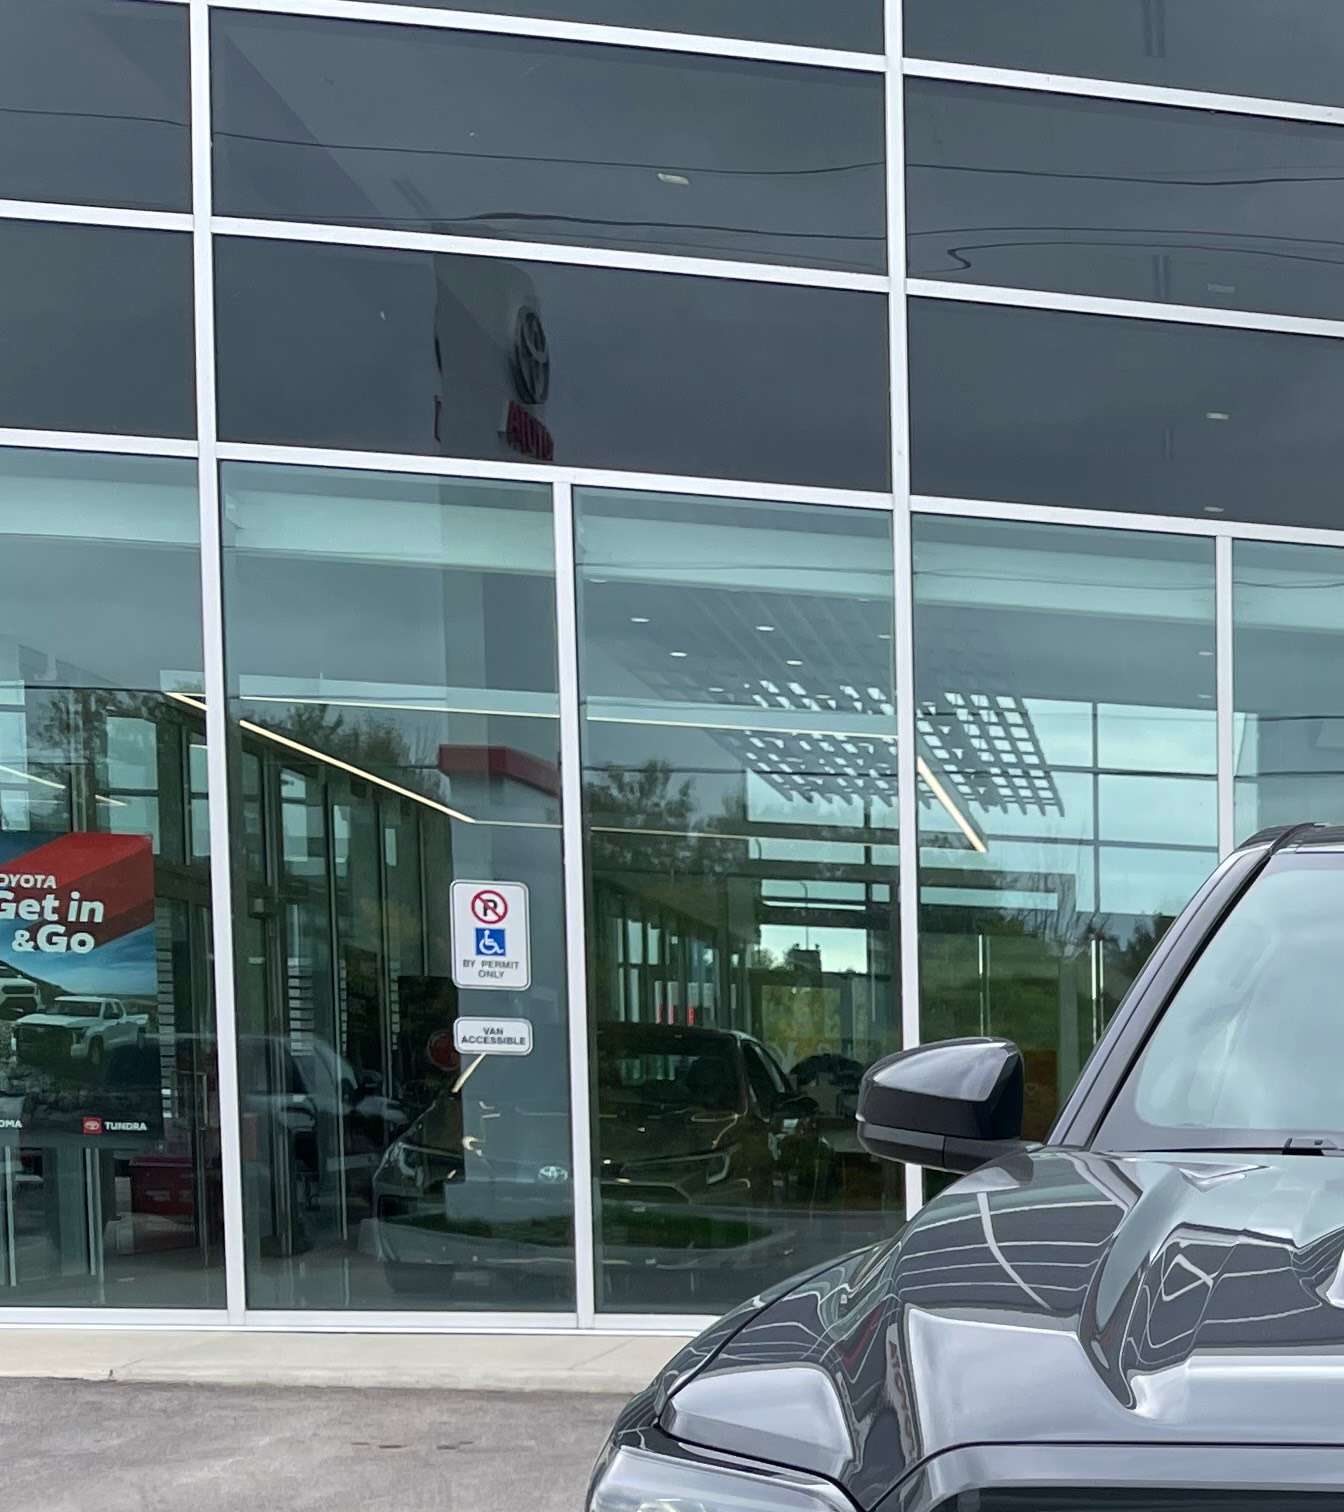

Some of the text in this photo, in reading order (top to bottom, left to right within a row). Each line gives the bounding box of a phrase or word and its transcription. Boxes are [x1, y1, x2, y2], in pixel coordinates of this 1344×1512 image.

[0, 889, 104, 923] Get in
[11, 924, 95, 954] &Go
[462, 959, 520, 970] BY PERMIT
[478, 970, 505, 979] ONLY
[483, 1027, 504, 1036] VAN
[461, 1035, 526, 1046] ACCESSIBLE
[104, 1121, 148, 1131] TUNDRA
